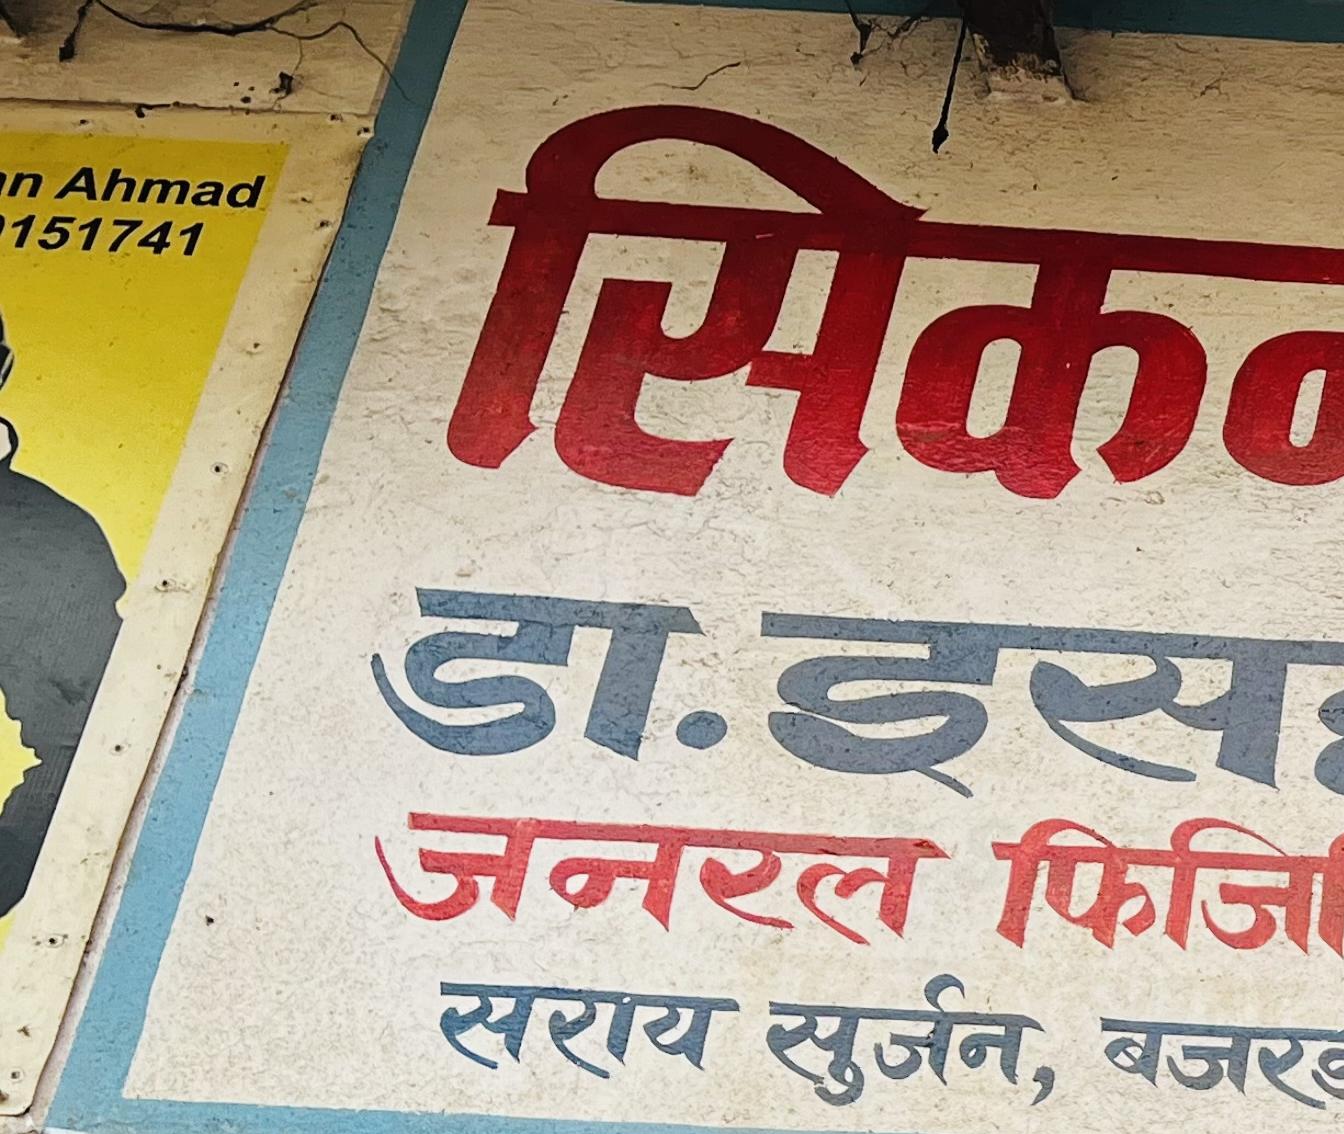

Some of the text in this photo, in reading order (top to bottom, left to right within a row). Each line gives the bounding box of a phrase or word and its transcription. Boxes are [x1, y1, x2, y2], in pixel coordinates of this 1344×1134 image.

[0, 167, 266, 208] n Ahmad
[0, 215, 204, 256] 151741
[376, 812, 951, 945] जनरल
[440, 982, 740, 1078] सराय
